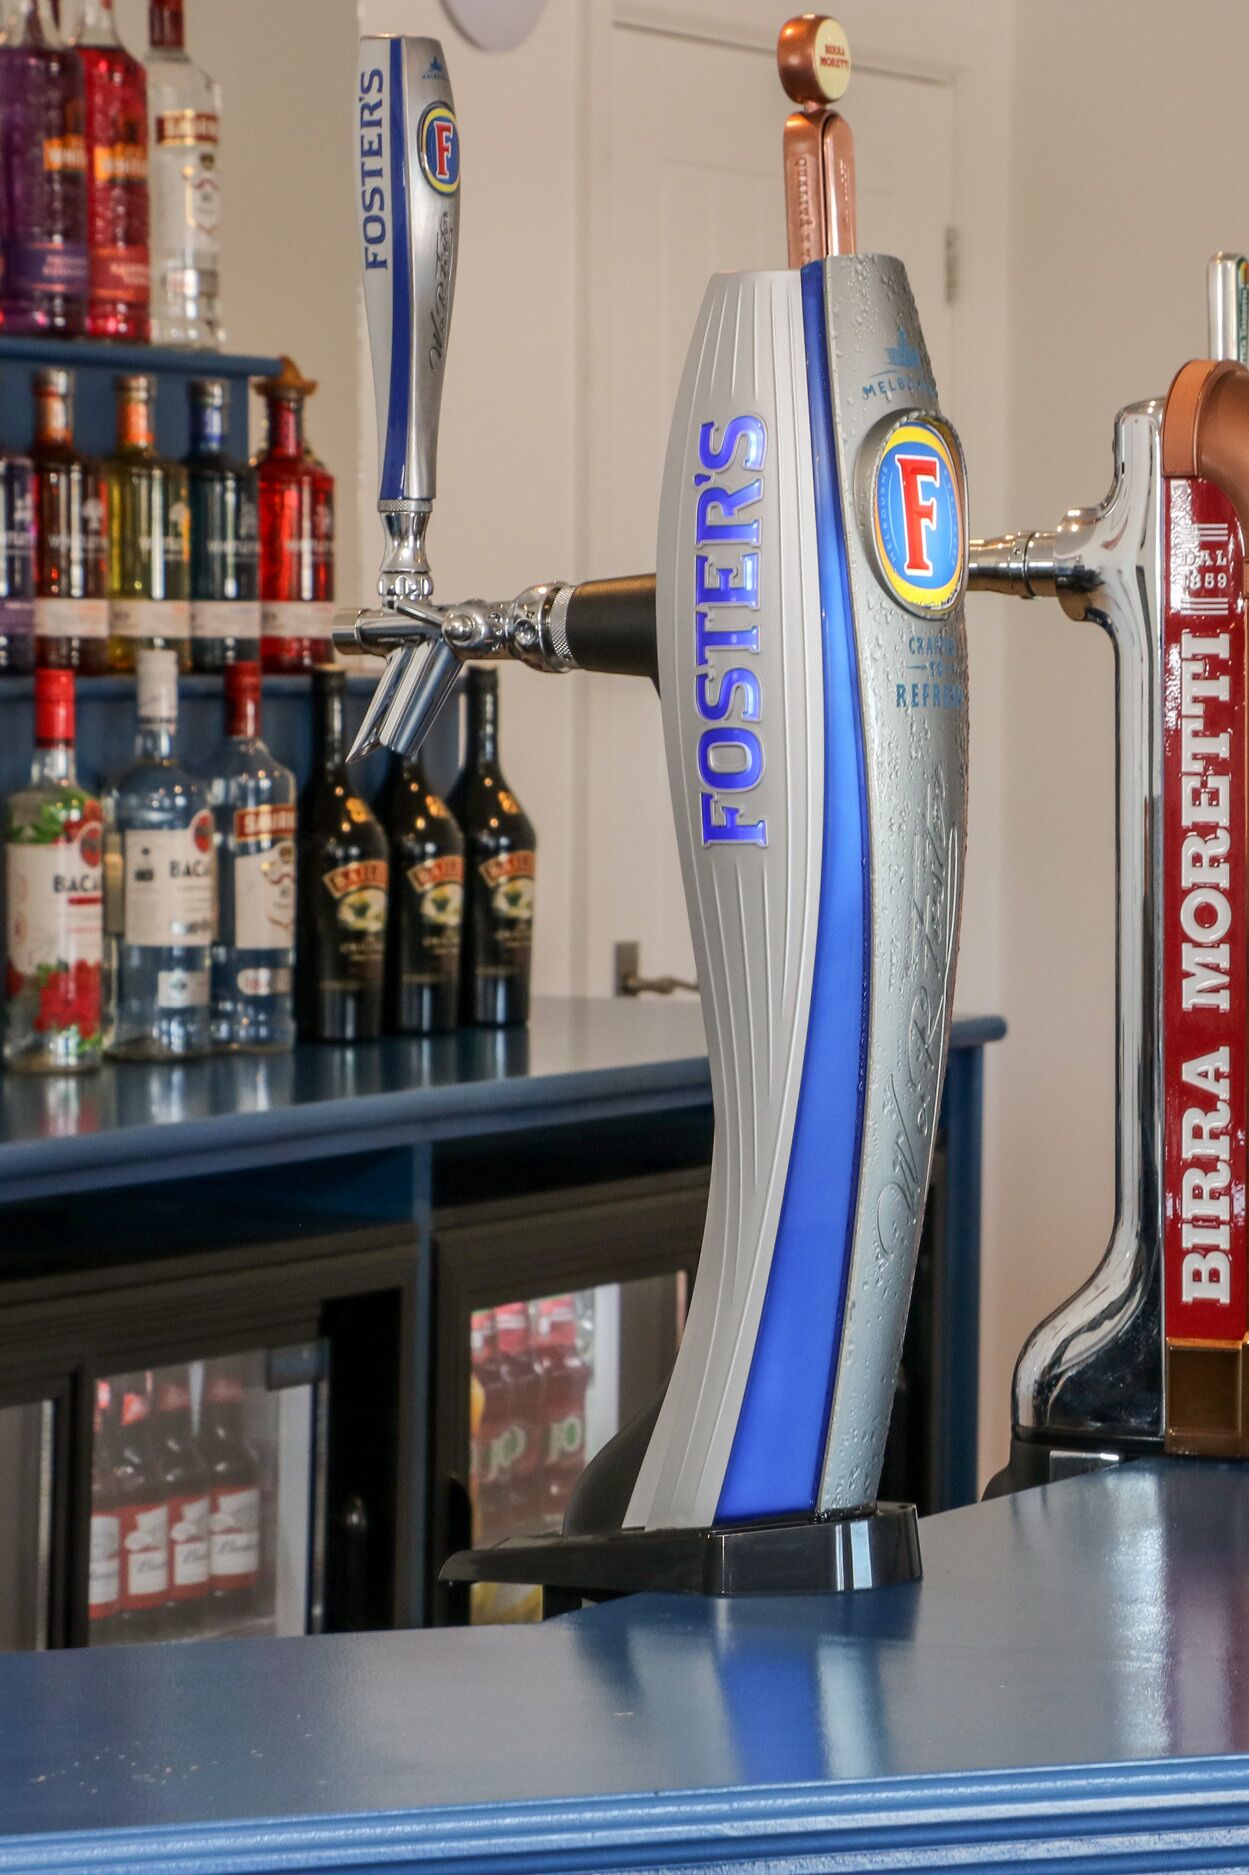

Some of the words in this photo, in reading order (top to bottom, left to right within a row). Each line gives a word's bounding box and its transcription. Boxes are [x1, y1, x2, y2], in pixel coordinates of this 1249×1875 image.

[359, 68, 388, 270] FOSTER'S
[434, 121, 453, 178] F
[895, 454, 940, 576] F
[1183, 549, 1227, 566] DAL
[694, 411, 767, 847] FOSTER'S
[1180, 629, 1232, 1013] MORETTI
[1180, 1046, 1232, 1305] BIRRA
